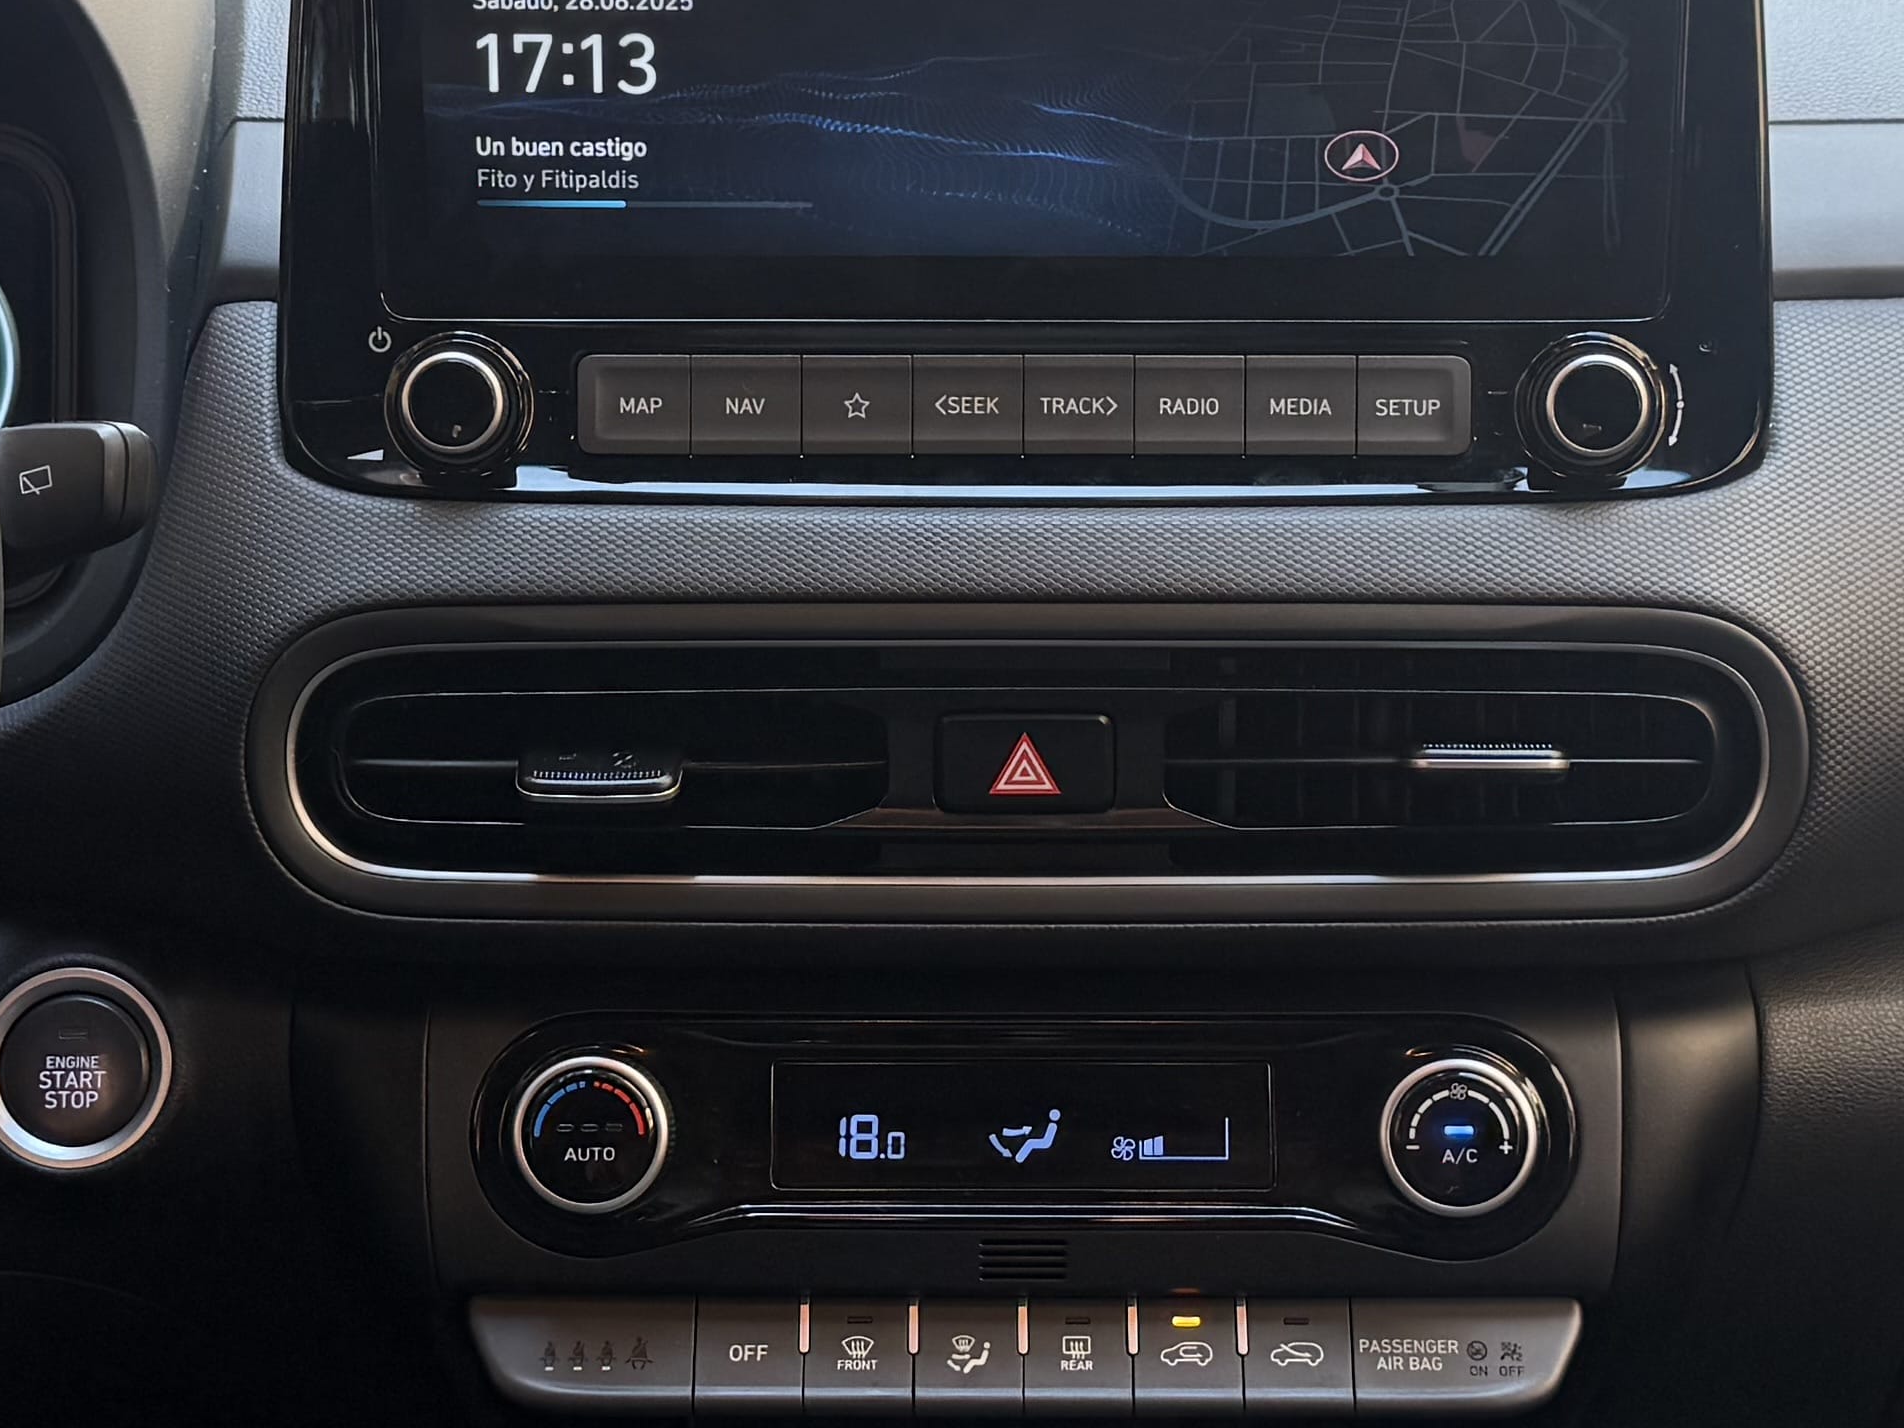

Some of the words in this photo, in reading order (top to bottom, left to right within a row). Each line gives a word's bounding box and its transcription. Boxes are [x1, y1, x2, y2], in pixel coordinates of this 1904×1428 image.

[476, 32, 657, 95] 17:13
[476, 136, 505, 157] Un
[511, 136, 564, 157] buen
[569, 136, 647, 162] castigo
[477, 168, 516, 189] Fito
[522, 174, 535, 193] y
[541, 169, 639, 193] Fitipaldis
[619, 396, 663, 414] MAP
[725, 397, 766, 415] NAV
[943, 394, 999, 416] SEEK
[1039, 395, 1110, 416] TRACK
[1159, 397, 1219, 416] RADIO
[1270, 397, 1332, 416] MEDIA
[1375, 398, 1441, 417] SETUP
[45, 1055, 100, 1069] ENGINE
[38, 1070, 107, 1089] START
[44, 1090, 99, 1109] STOP
[838, 1114, 906, 1160] 18.0
[564, 1146, 616, 1162] AUTO
[1442, 1147, 1478, 1165] A/C
[729, 1344, 769, 1362] OFF
[1358, 1337, 1460, 1355] PASSENGER
[836, 1359, 878, 1372] FRONT
[1060, 1359, 1095, 1372] REAR
[1376, 1355, 1405, 1372] AIR
[1408, 1355, 1444, 1372] BAG
[1468, 1364, 1490, 1378] ON
[1498, 1364, 1526, 1378] OFF
